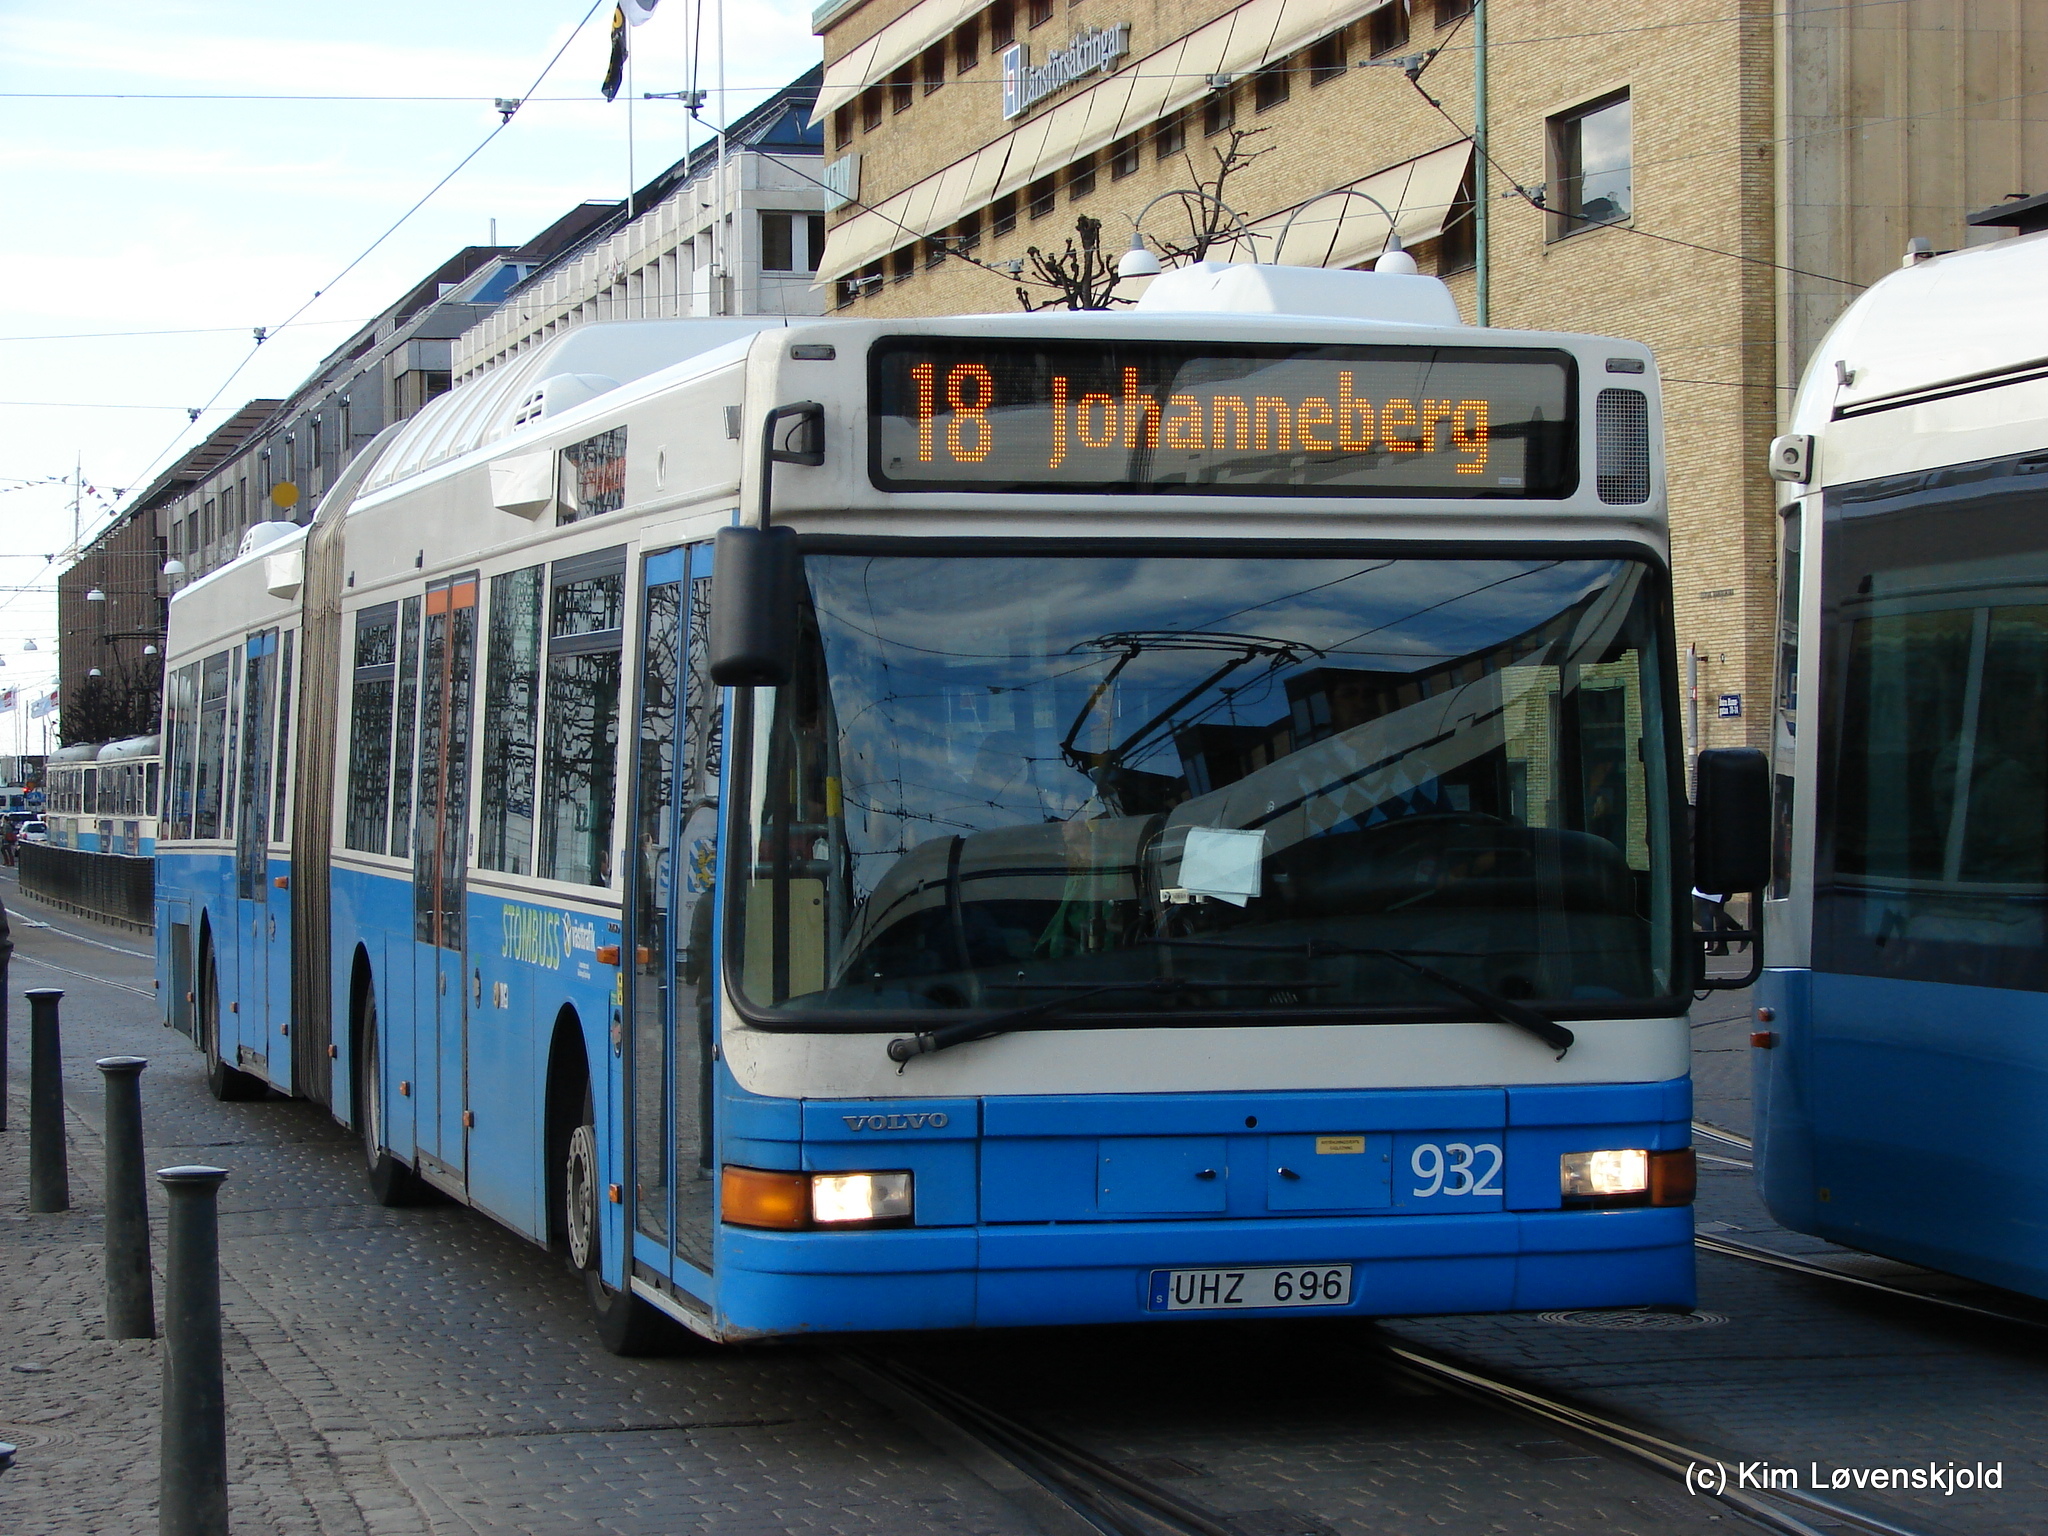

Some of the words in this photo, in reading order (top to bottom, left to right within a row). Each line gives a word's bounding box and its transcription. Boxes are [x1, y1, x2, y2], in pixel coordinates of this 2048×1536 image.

[1021, 22, 1125, 107] Länsförsäkringar
[911, 363, 993, 463] 18
[502, 903, 560, 970] STOMBUSS
[842, 1112, 948, 1132] VOLVO
[1410, 1143, 1504, 1198] 932
[1174, 1272, 1246, 1305] UHZ
[1273, 1269, 1343, 1301] 696
